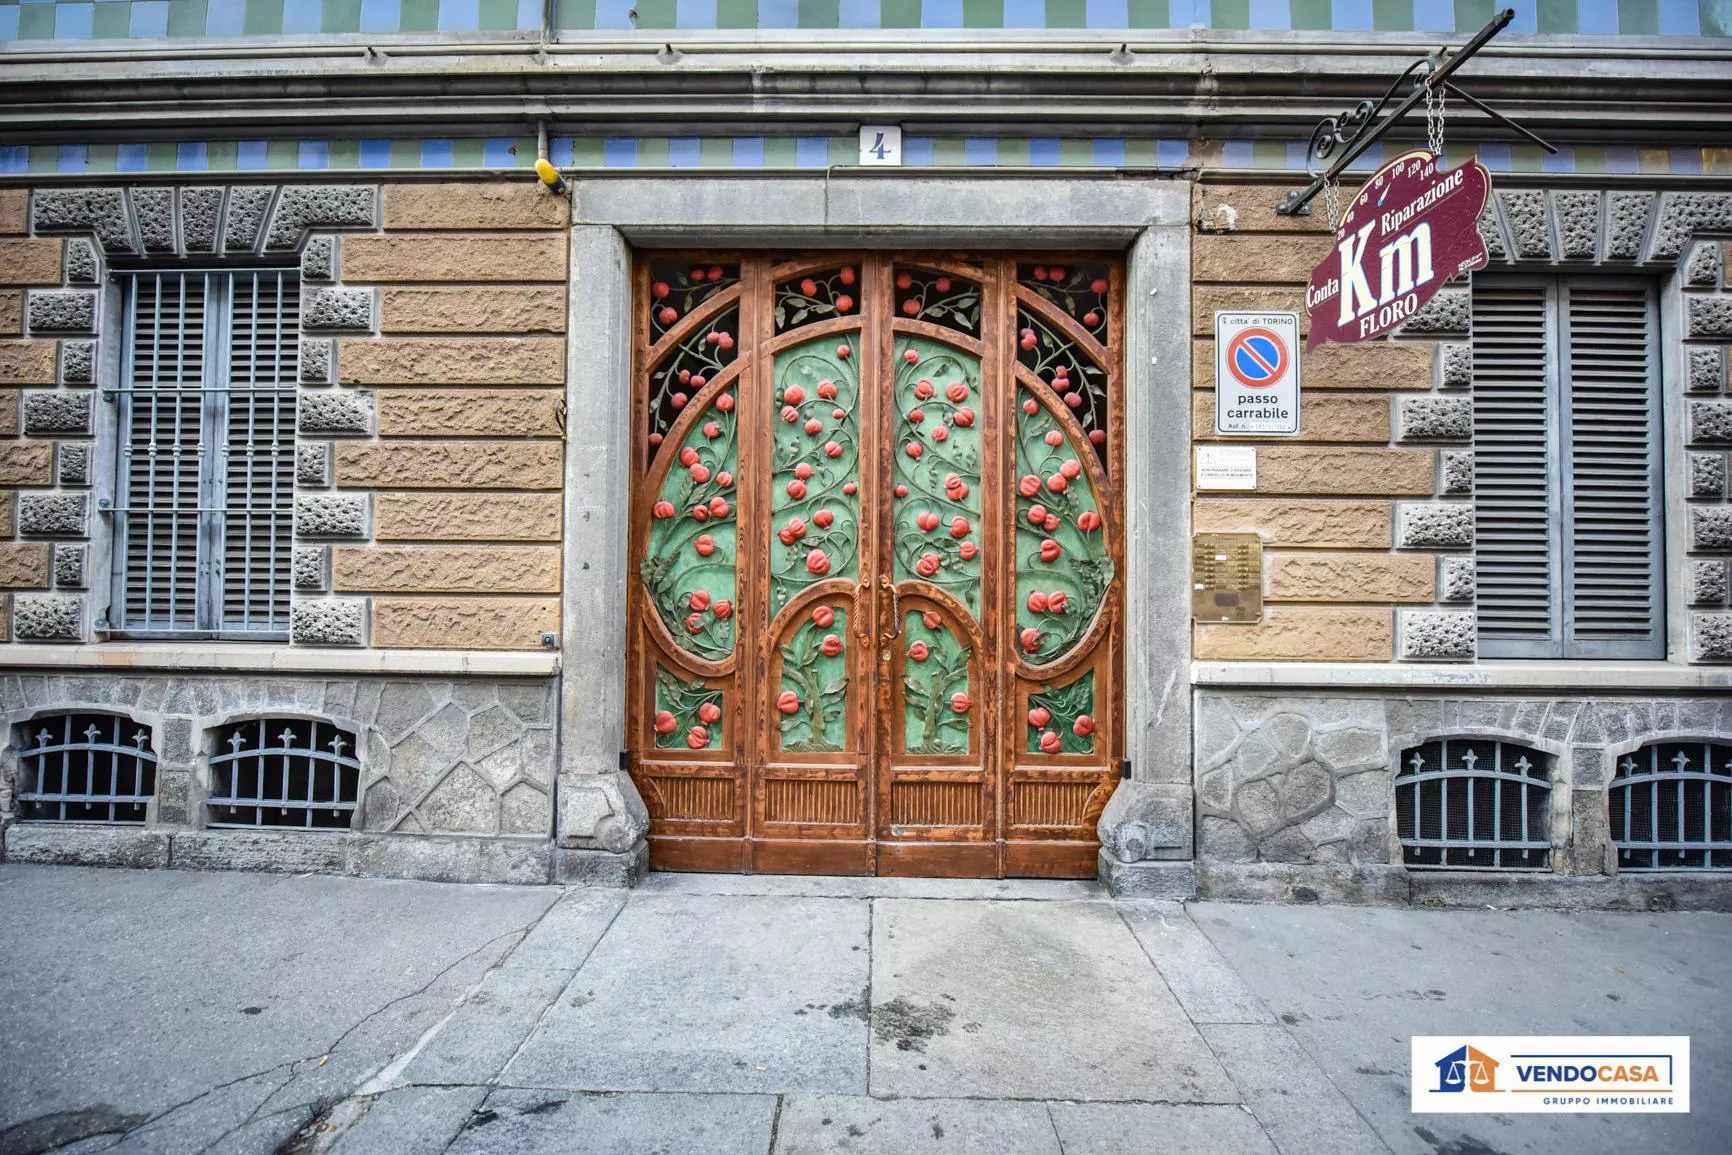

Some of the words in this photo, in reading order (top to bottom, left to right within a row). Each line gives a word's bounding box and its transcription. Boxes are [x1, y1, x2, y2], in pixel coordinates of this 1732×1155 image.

[869, 132, 891, 160] 4
[1336, 228, 1346, 241] 20
[1360, 192, 1369, 206] 60
[1374, 176, 1384, 190] 80
[1391, 161, 1405, 179] 100
[1407, 160, 1421, 178] 120
[1420, 162, 1434, 181] 140
[1381, 168, 1464, 236] Riparazione
[1306, 278, 1340, 309] Conta
[1337, 219, 1435, 328] Km
[1359, 292, 1418, 339] FLORO
[1227, 408, 1289, 419] carrabile
[1238, 395, 1278, 406] passo
